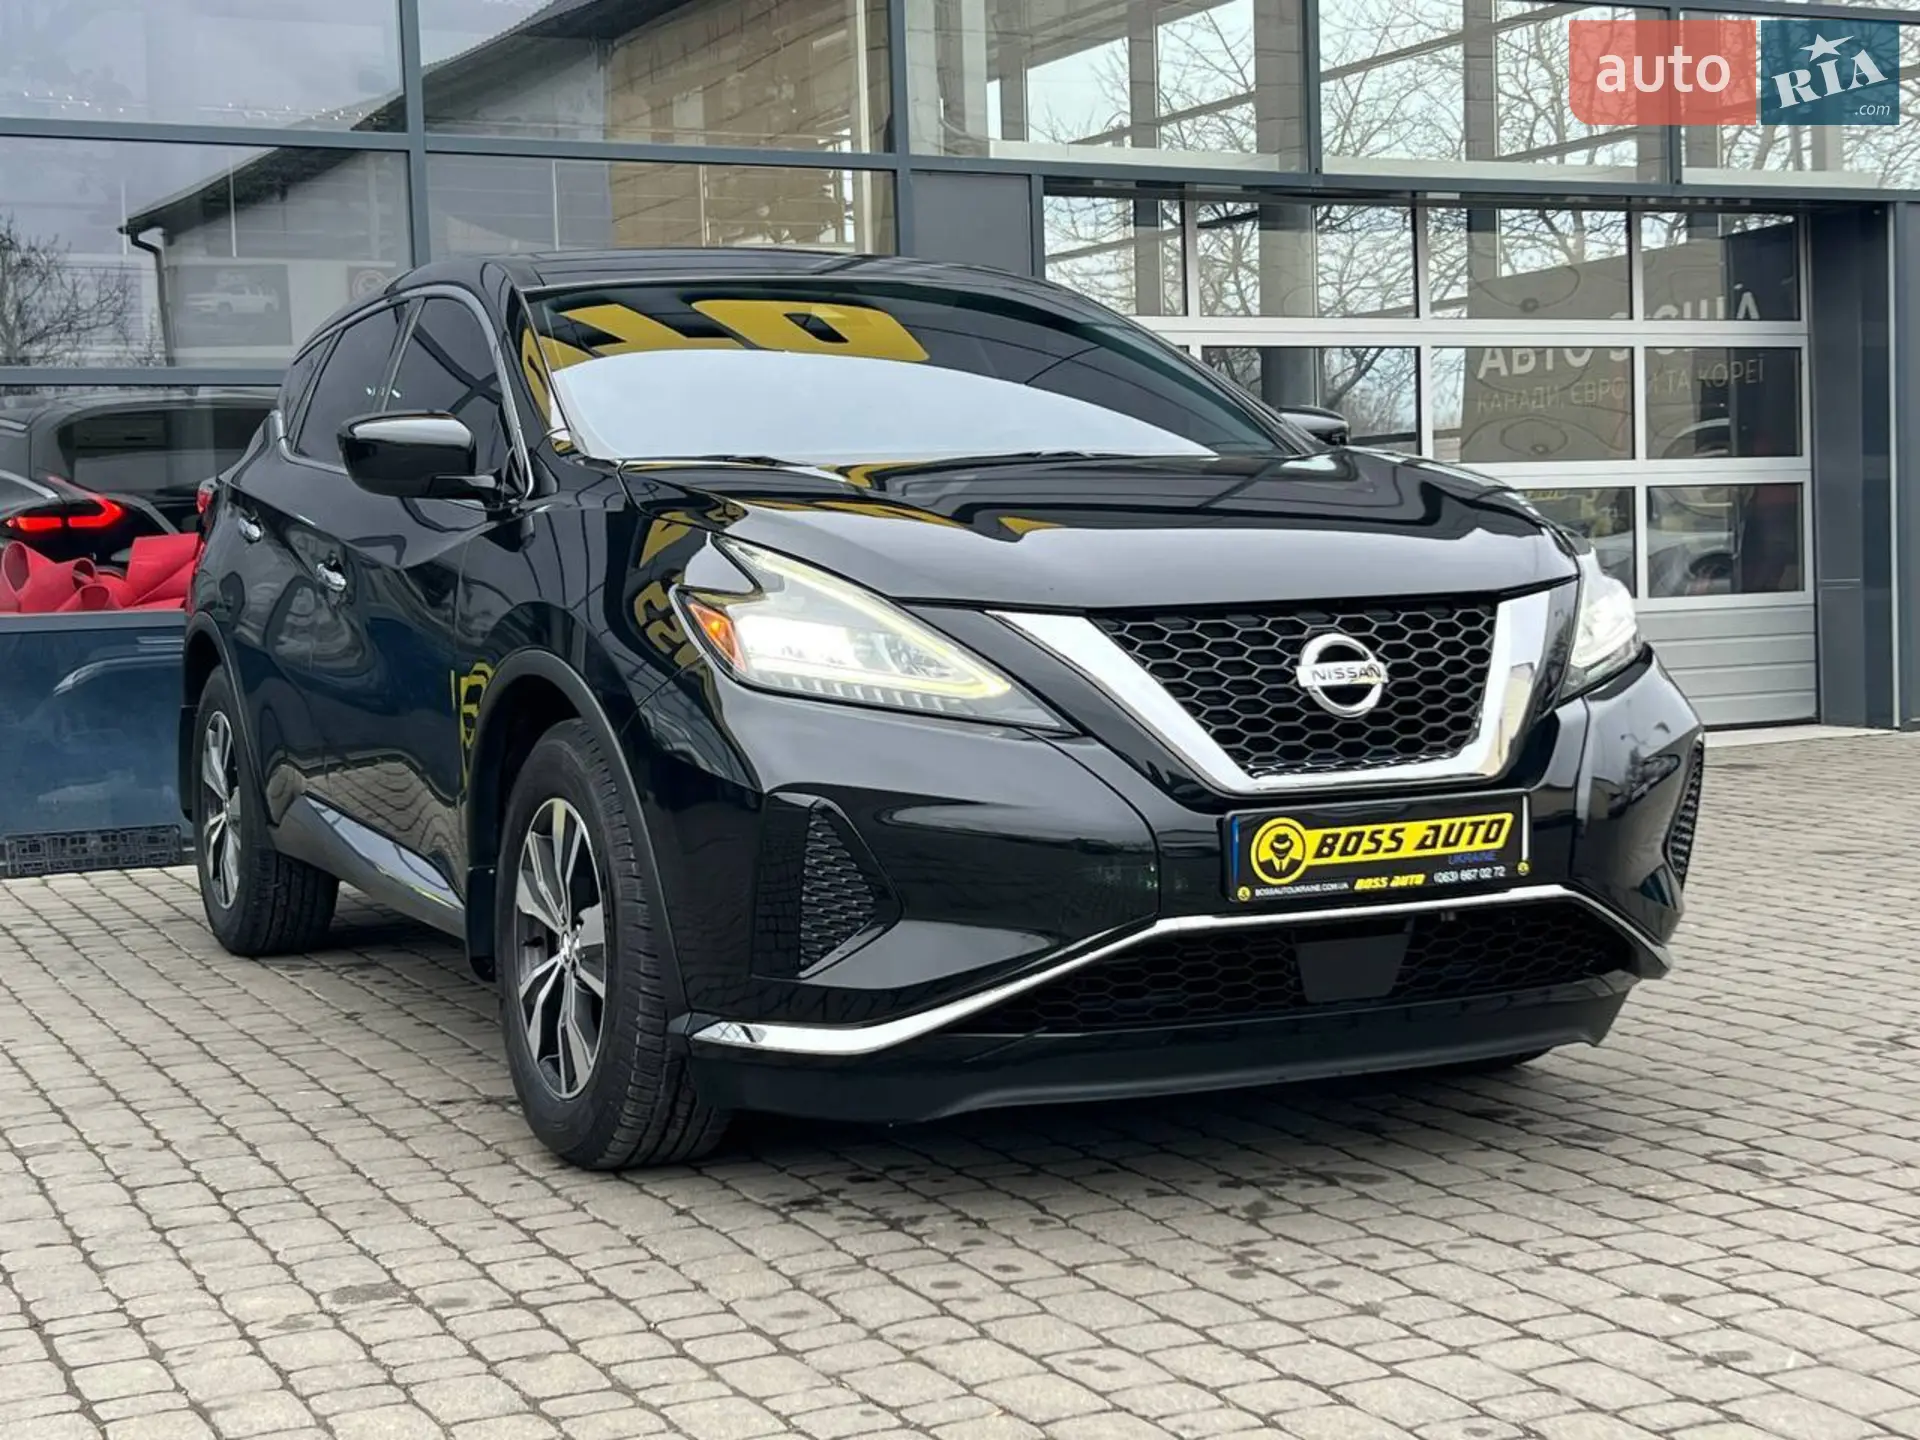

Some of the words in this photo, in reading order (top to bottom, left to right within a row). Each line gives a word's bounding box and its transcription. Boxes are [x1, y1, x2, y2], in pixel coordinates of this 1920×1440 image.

[1311, 663, 1382, 682] NISSAN
[1313, 828, 1406, 859] BOSS
[1413, 818, 1507, 851] AUTO
[1353, 876, 1389, 890] BOSS
